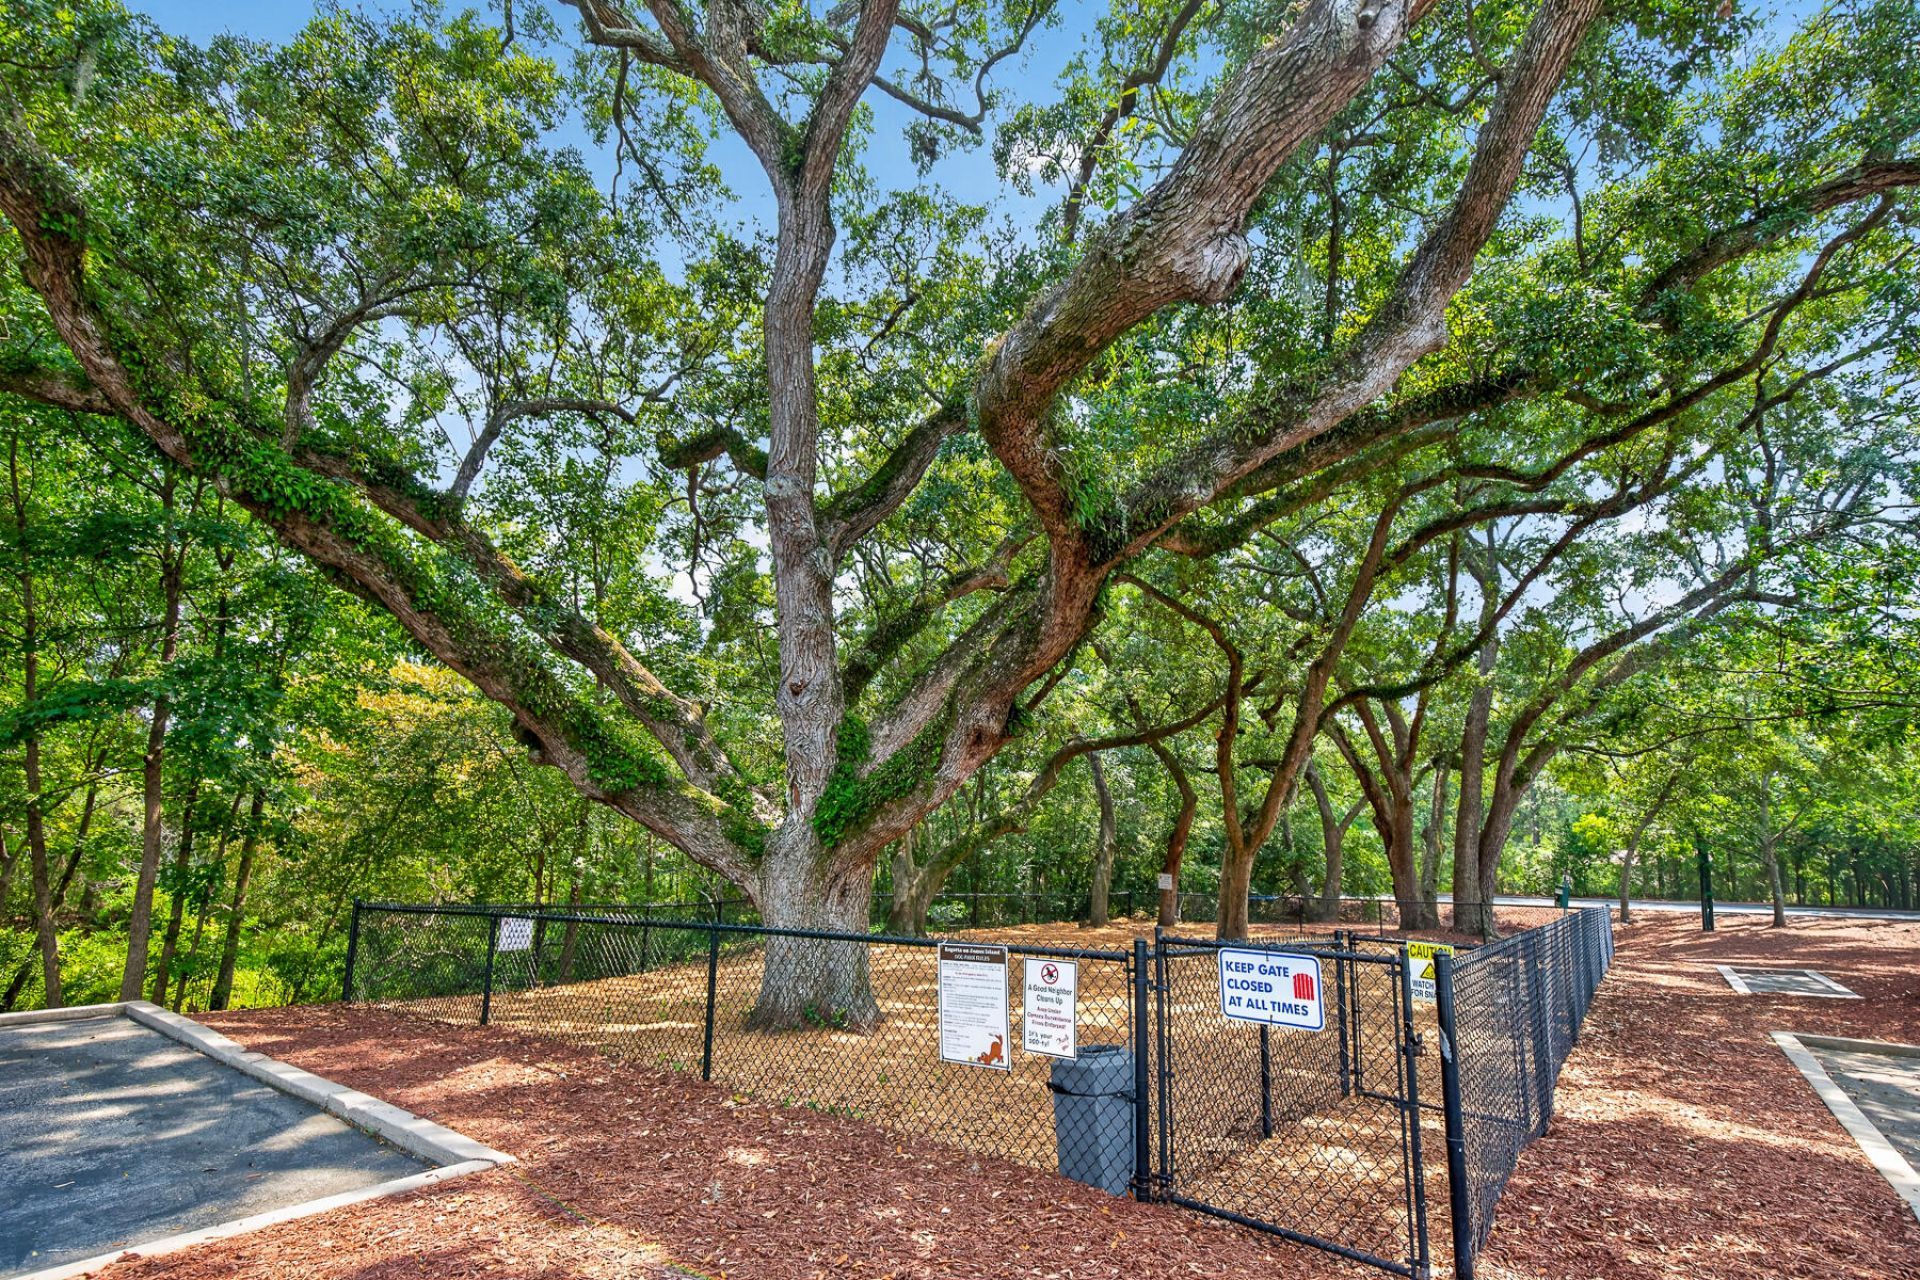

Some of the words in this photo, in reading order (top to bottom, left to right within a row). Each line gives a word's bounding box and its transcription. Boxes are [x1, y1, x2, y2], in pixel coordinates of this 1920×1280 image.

[1410, 944, 1451, 959] CAUT
[1225, 960, 1255, 974] KEEP
[1258, 964, 1289, 977] GATE
[1033, 984, 1047, 993] Good
[1048, 986, 1072, 996] Neighbor
[1227, 978, 1273, 993] CLOSED
[1412, 979, 1435, 990] WATCH
[1411, 989, 1424, 997] FOR
[1036, 994, 1054, 1003] Cleans
[1055, 997, 1063, 1006] Up
[1228, 995, 1242, 1007] AT
[1246, 998, 1268, 1011] ALL
[1270, 1000, 1309, 1016] TIMES
